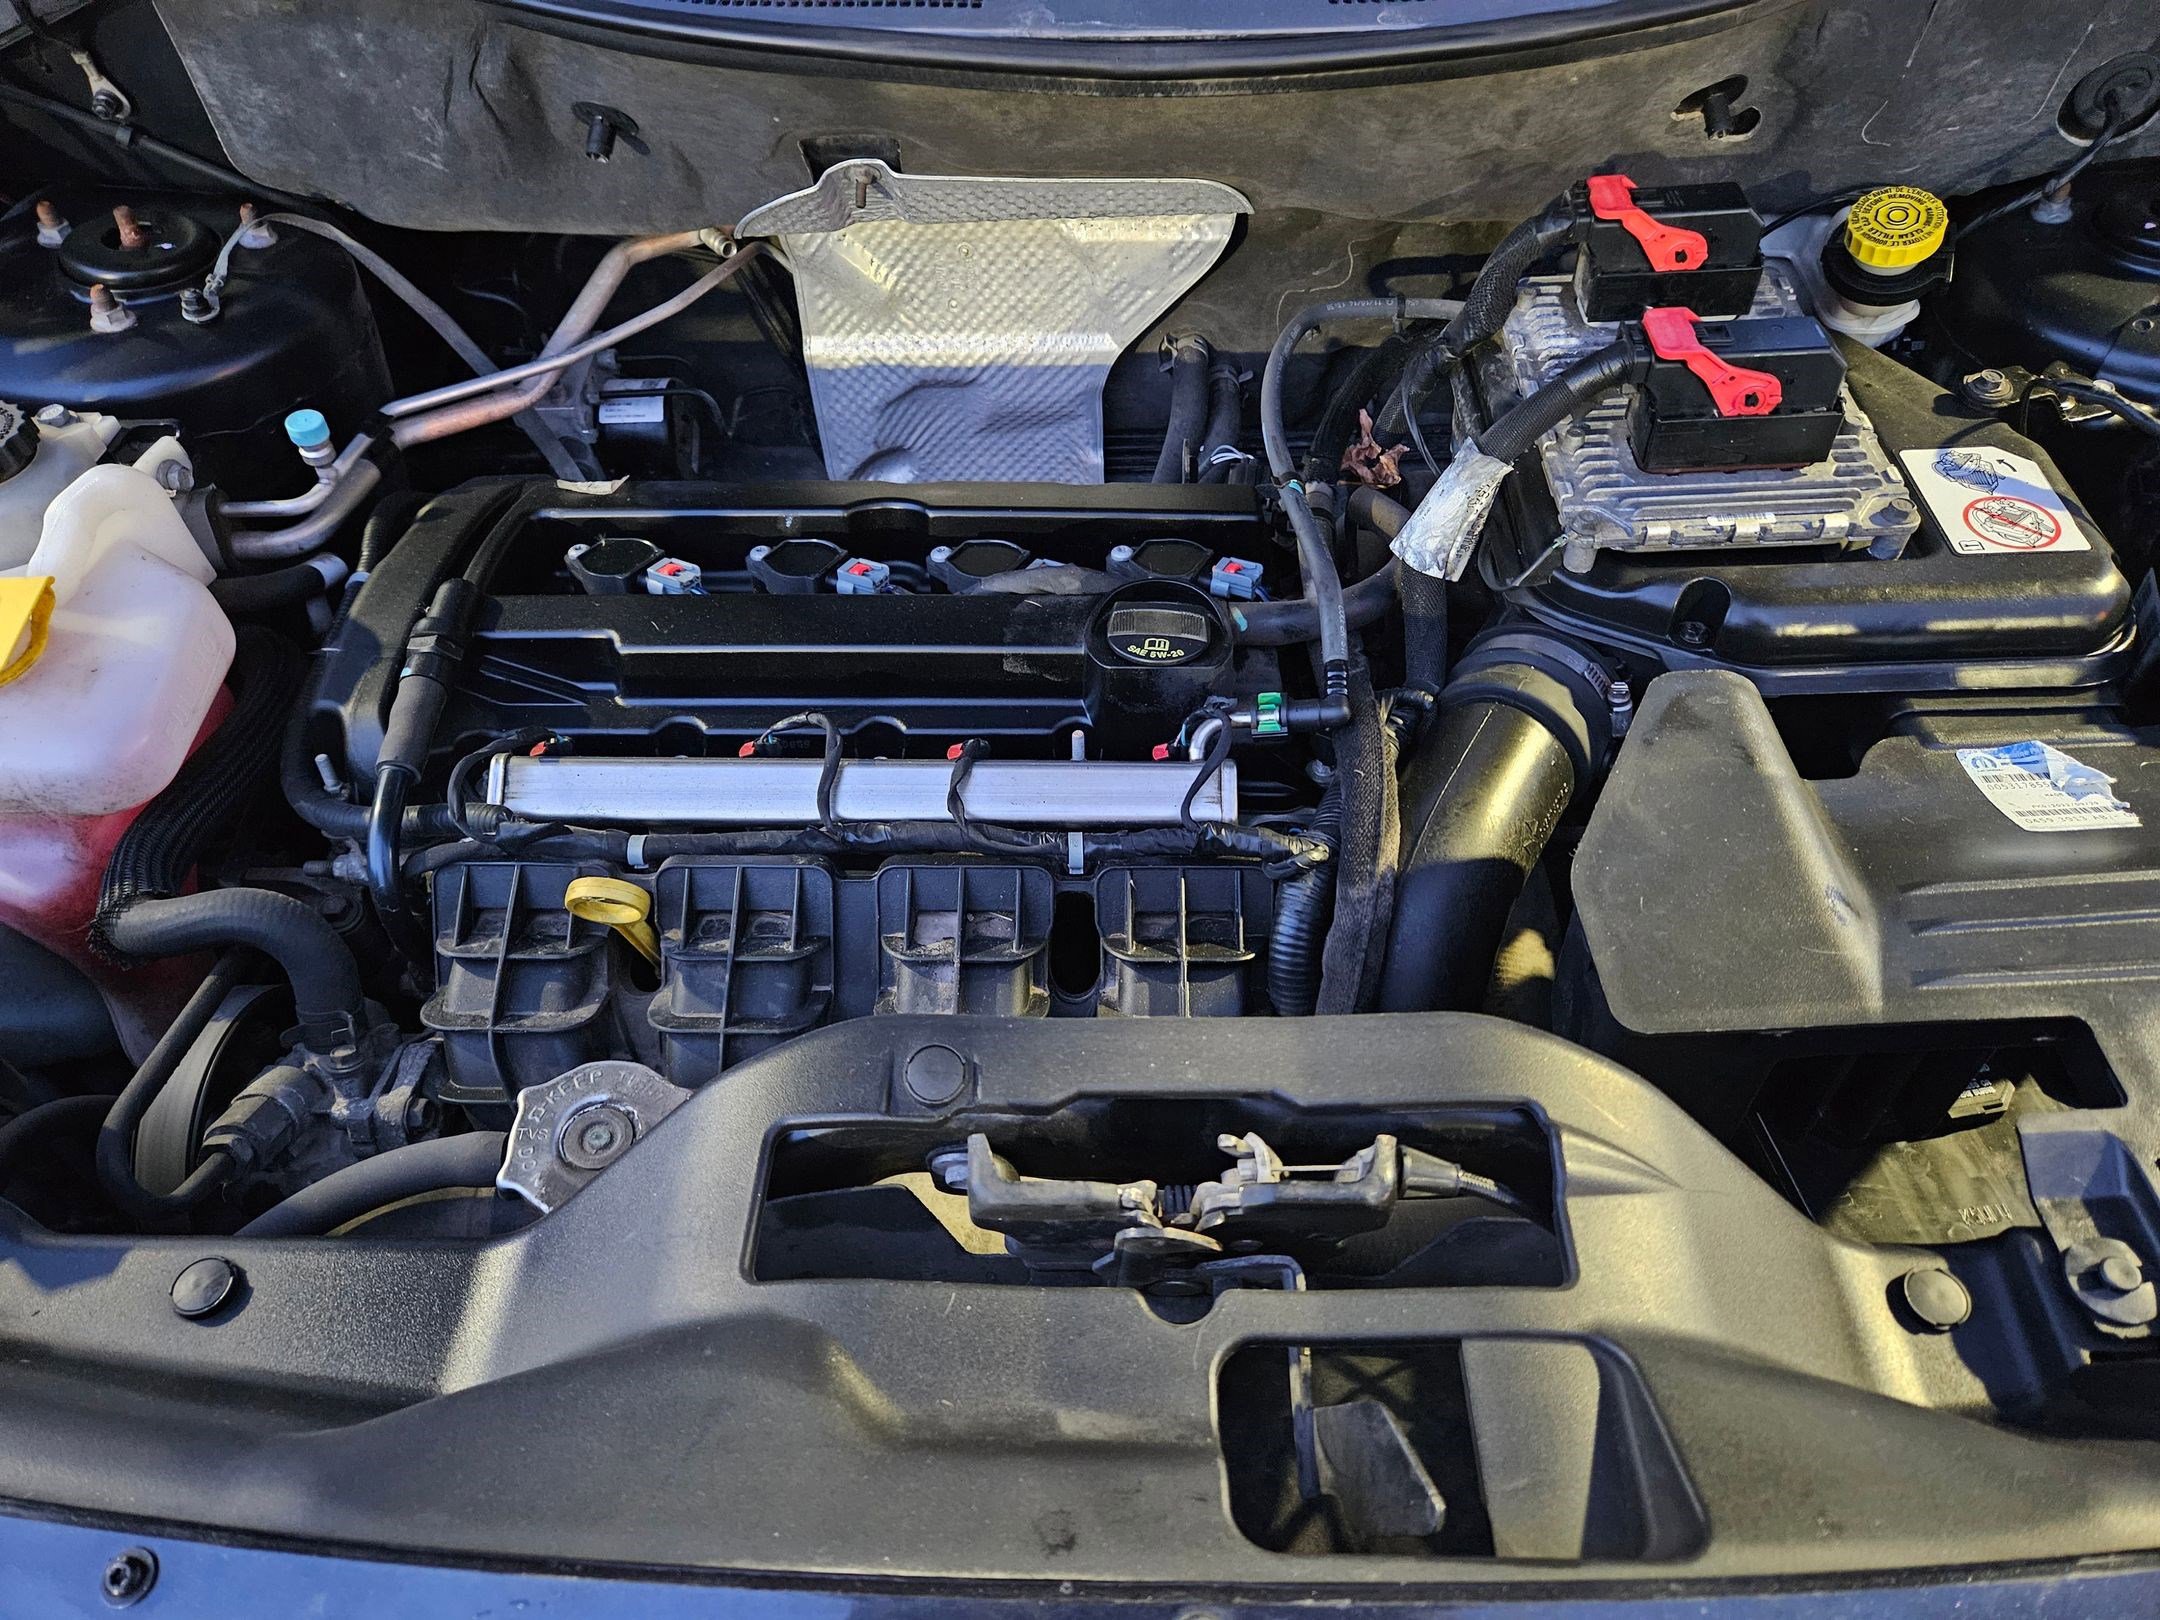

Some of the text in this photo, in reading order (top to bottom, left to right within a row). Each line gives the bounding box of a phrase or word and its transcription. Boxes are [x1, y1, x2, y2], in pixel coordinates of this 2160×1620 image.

[1127, 645, 1185, 659] SAE 5W-20
[546, 1071, 604, 1105] KEEP
[517, 1127, 549, 1141] TVS
